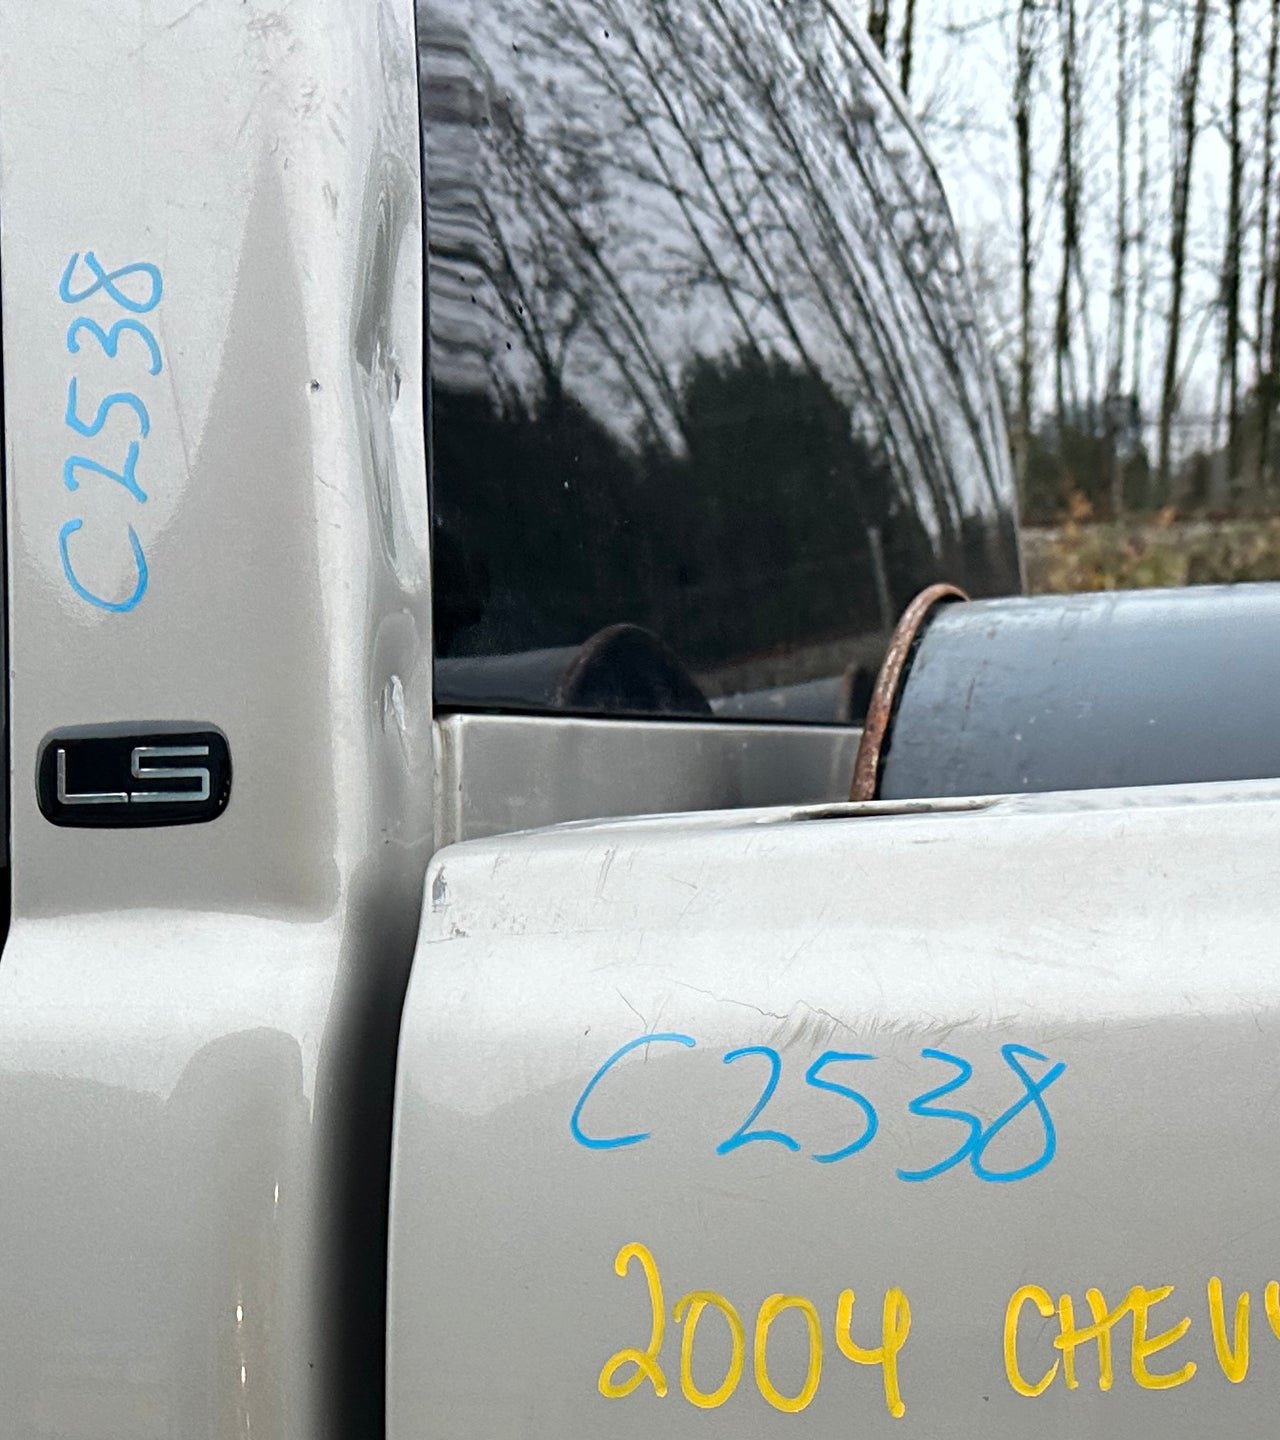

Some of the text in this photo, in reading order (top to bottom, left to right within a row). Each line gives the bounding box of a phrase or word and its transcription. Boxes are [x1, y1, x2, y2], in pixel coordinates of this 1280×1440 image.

[59, 250, 164, 615] C2538
[56, 745, 211, 805] LS
[597, 1241, 913, 1419] 2004
